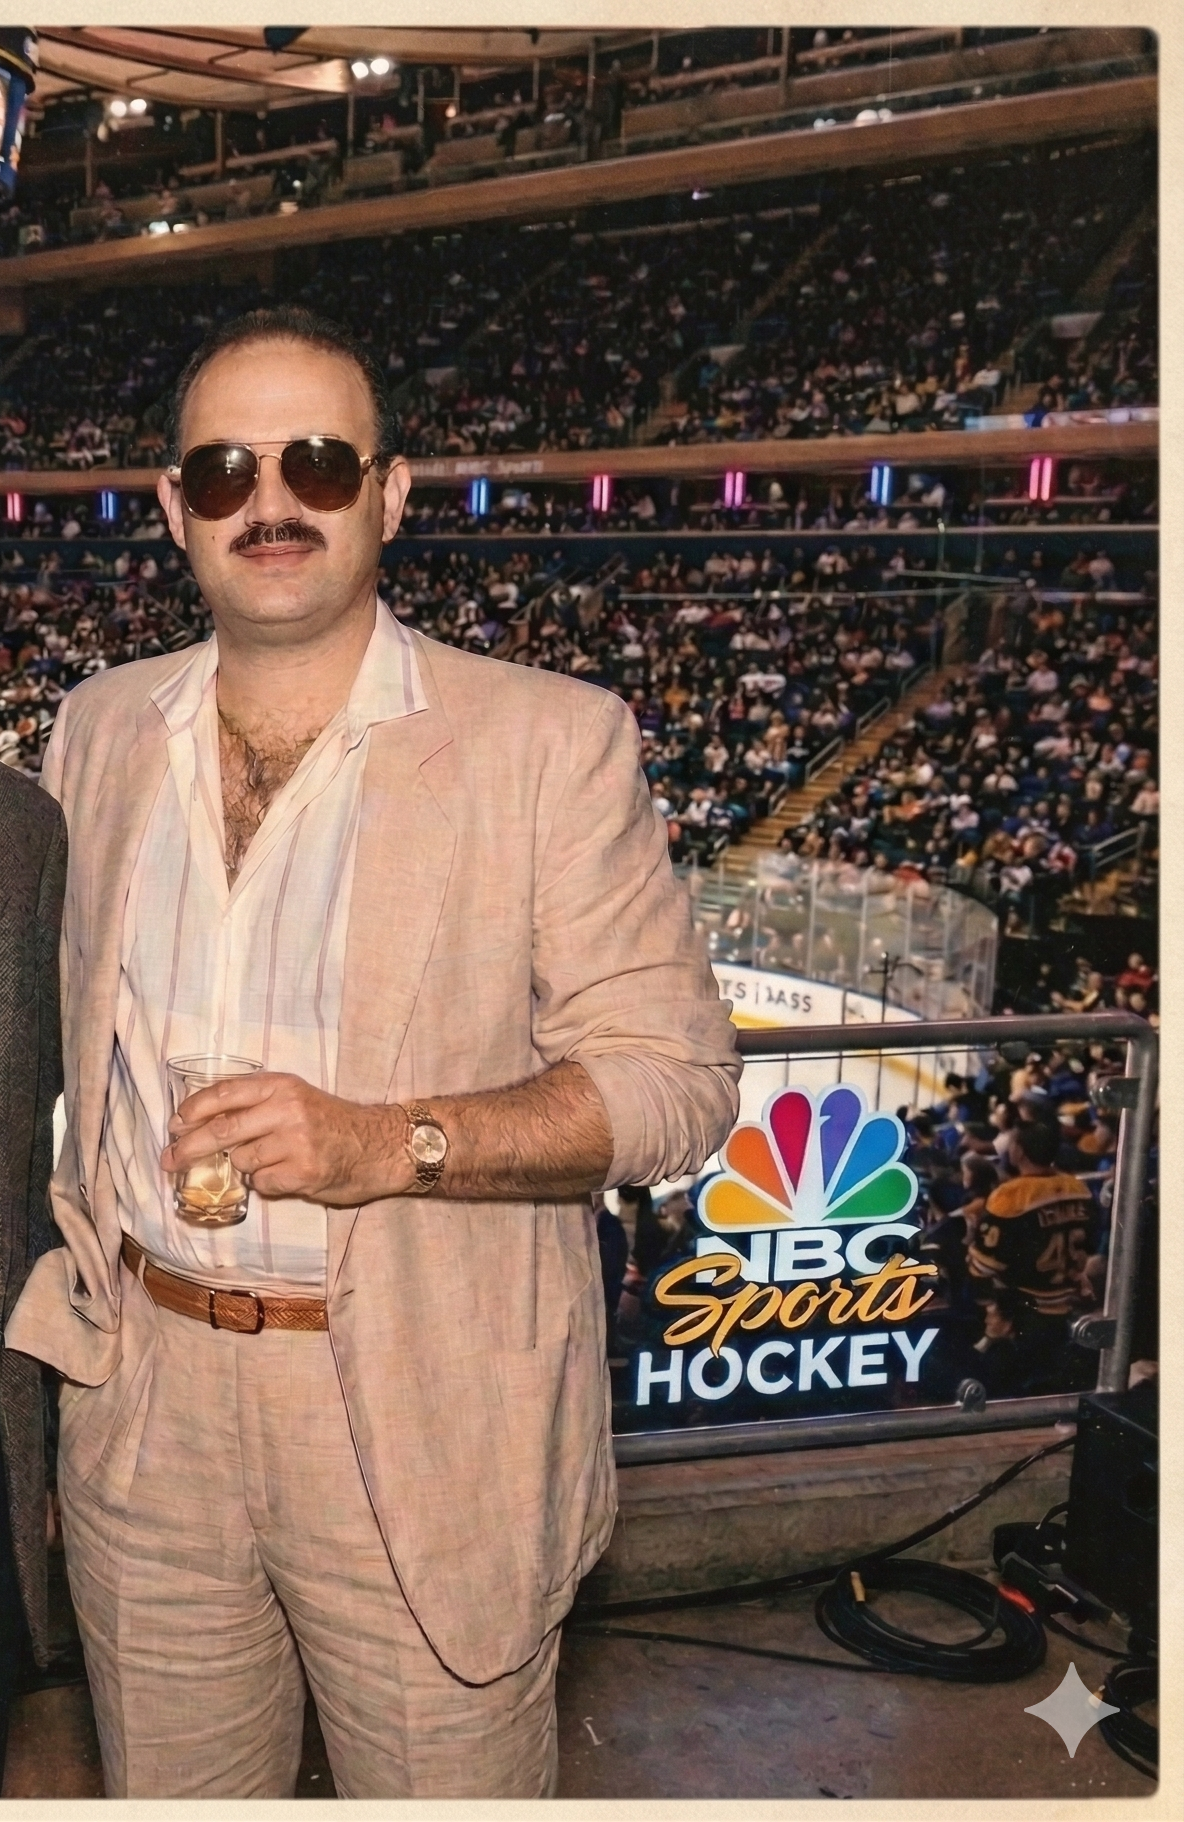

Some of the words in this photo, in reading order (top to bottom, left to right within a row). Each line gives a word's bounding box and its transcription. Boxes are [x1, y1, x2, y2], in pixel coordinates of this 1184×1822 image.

[695, 1222, 922, 1284] NBC
[654, 1252, 939, 1359] Sports
[636, 1328, 941, 1406] HOCKEY
